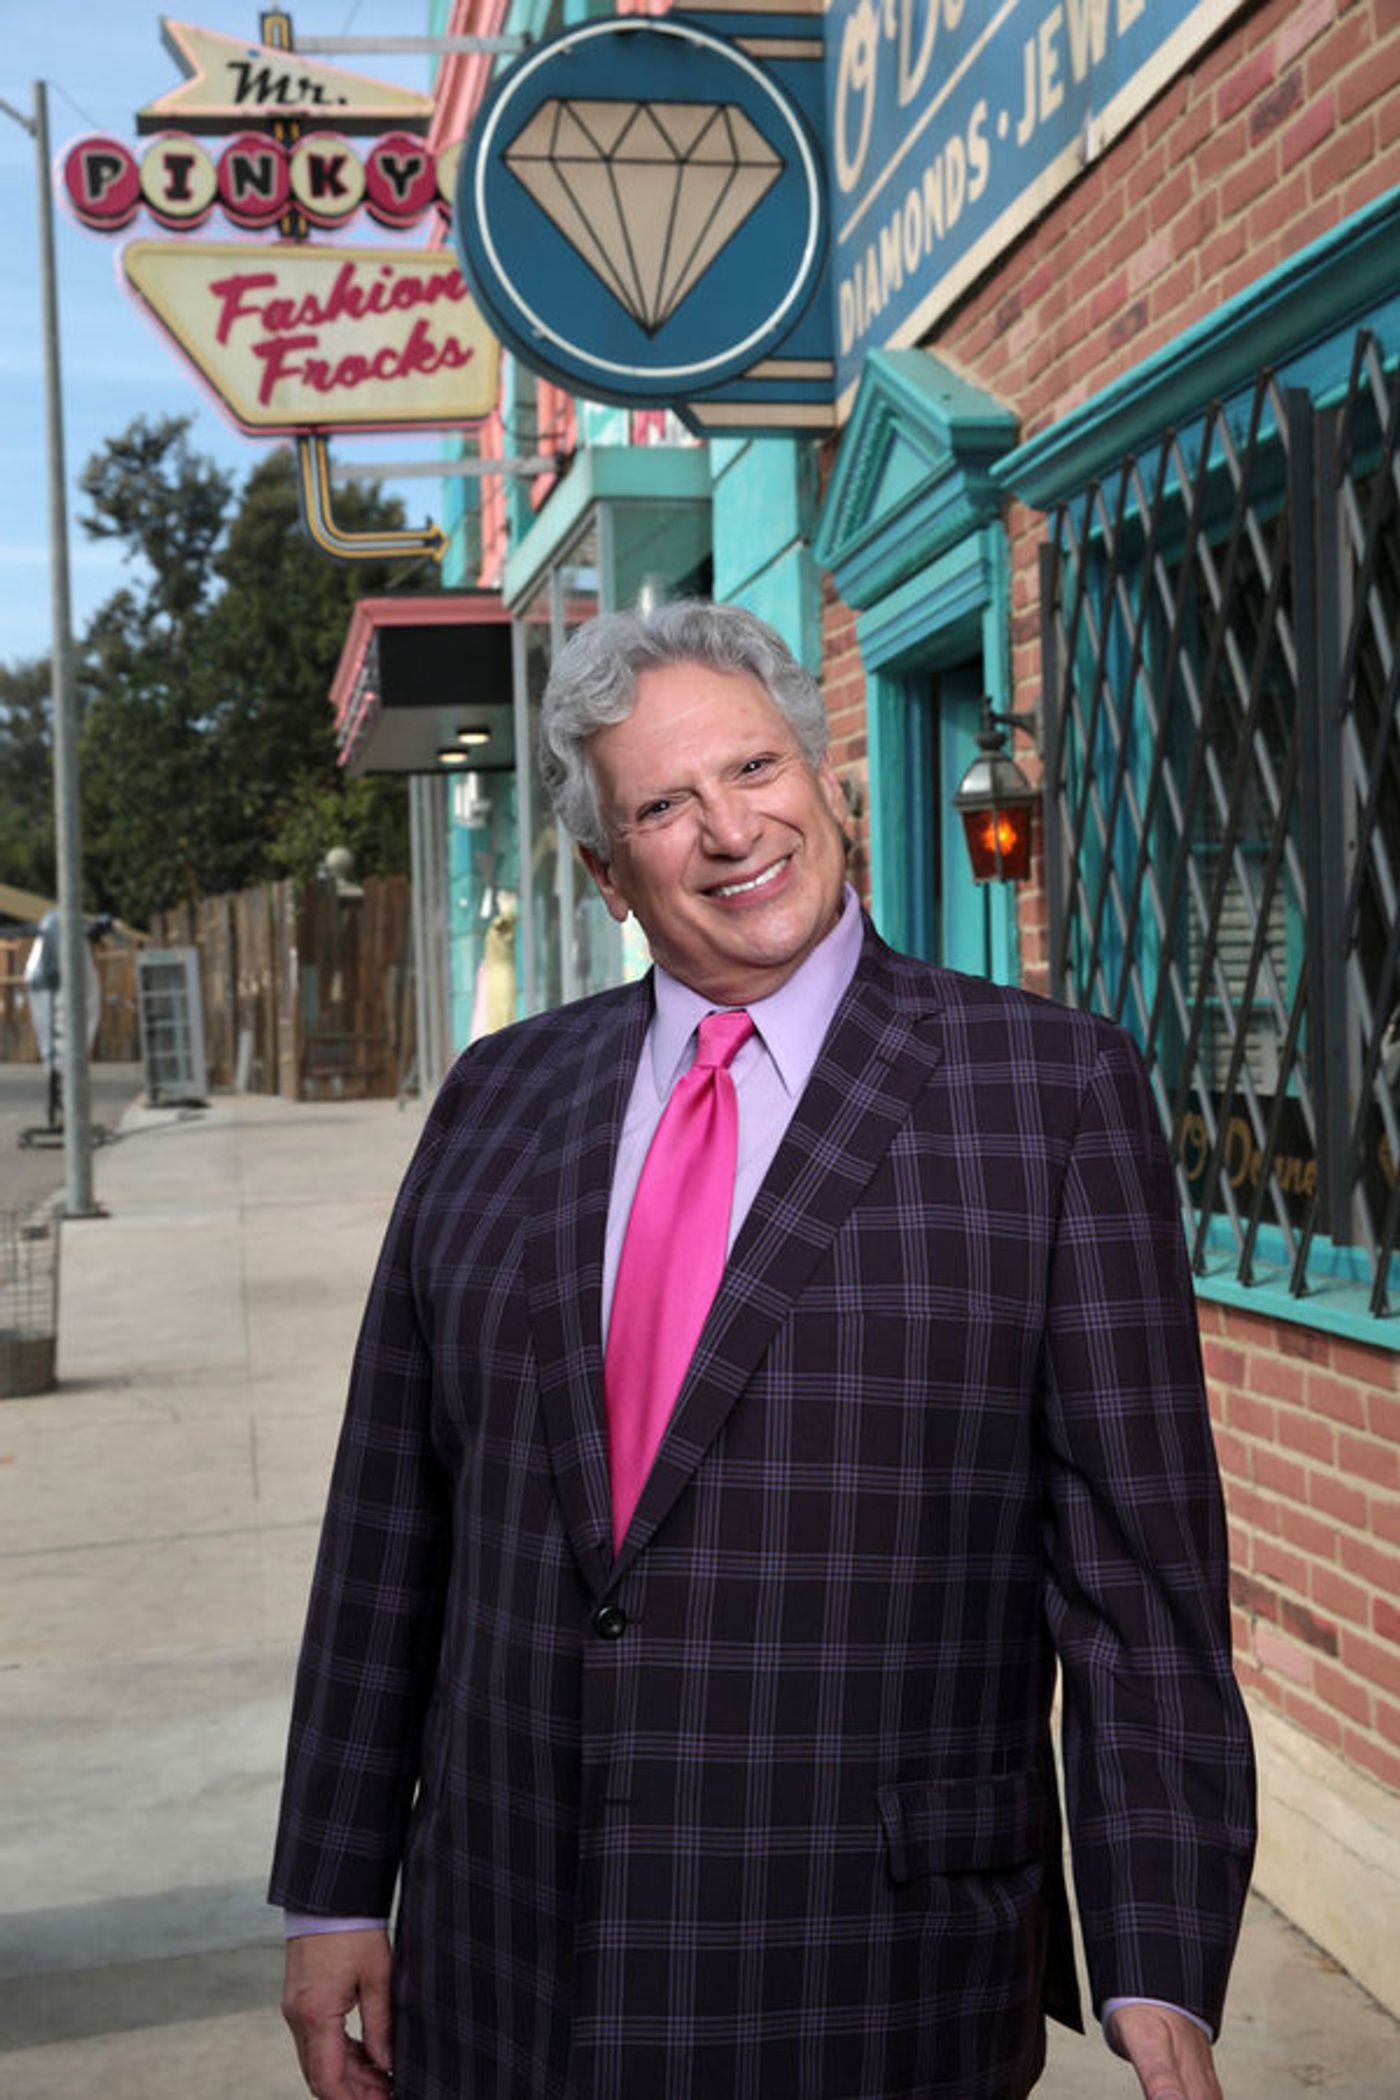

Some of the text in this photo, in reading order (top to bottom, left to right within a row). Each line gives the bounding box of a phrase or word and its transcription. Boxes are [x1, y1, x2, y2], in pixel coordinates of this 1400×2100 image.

[227, 62, 348, 106] Mr.
[83, 152, 424, 202] PINKY
[840, 98, 989, 355] DIAMONDS
[208, 261, 469, 347] Fashion
[251, 318, 474, 407] Frocks
